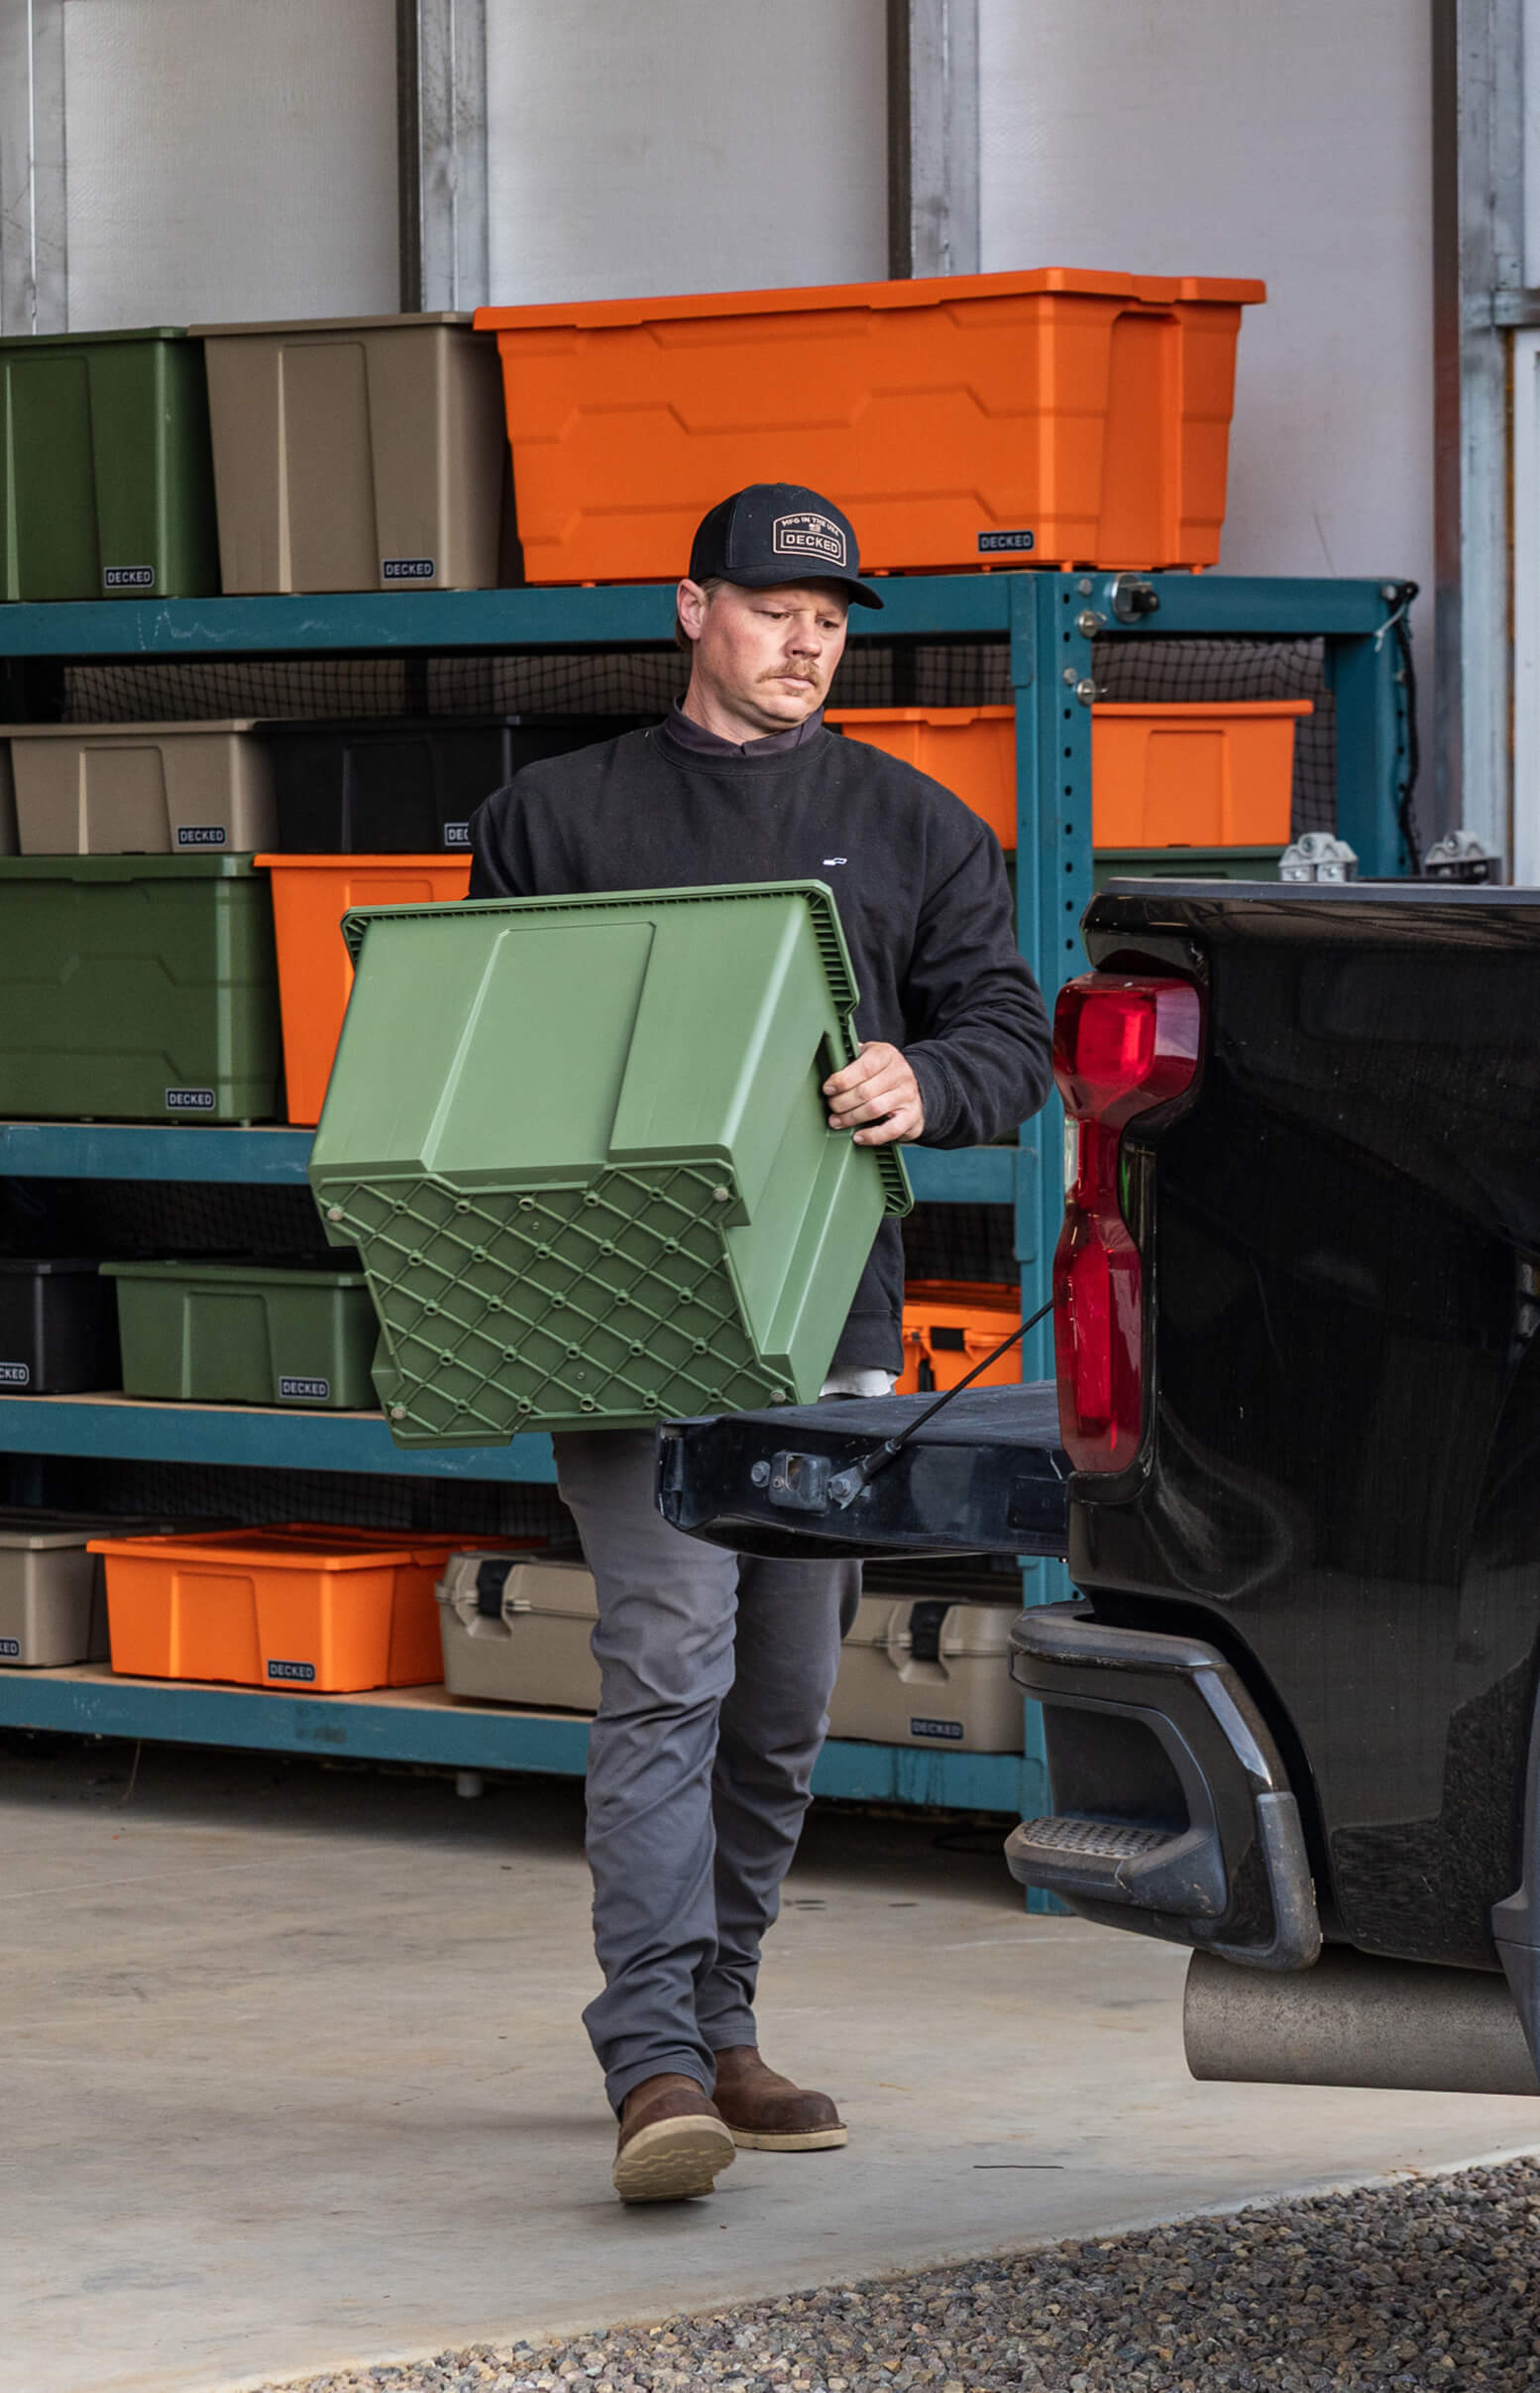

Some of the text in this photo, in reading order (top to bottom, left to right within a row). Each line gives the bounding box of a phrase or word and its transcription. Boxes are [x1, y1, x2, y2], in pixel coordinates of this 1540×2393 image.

[812, 517, 826, 528] THE
[786, 534, 838, 553] DECKED
[980, 534, 1032, 548] DECKED
[385, 562, 432, 576] DECKED
[107, 571, 152, 584] DECKED
[180, 830, 223, 842] DECKED
[169, 1091, 212, 1105] DECKED
[282, 1381, 327, 1395] DECKED
[270, 1662, 314, 1678] DECKED
[912, 1721, 961, 1737] DECKED
